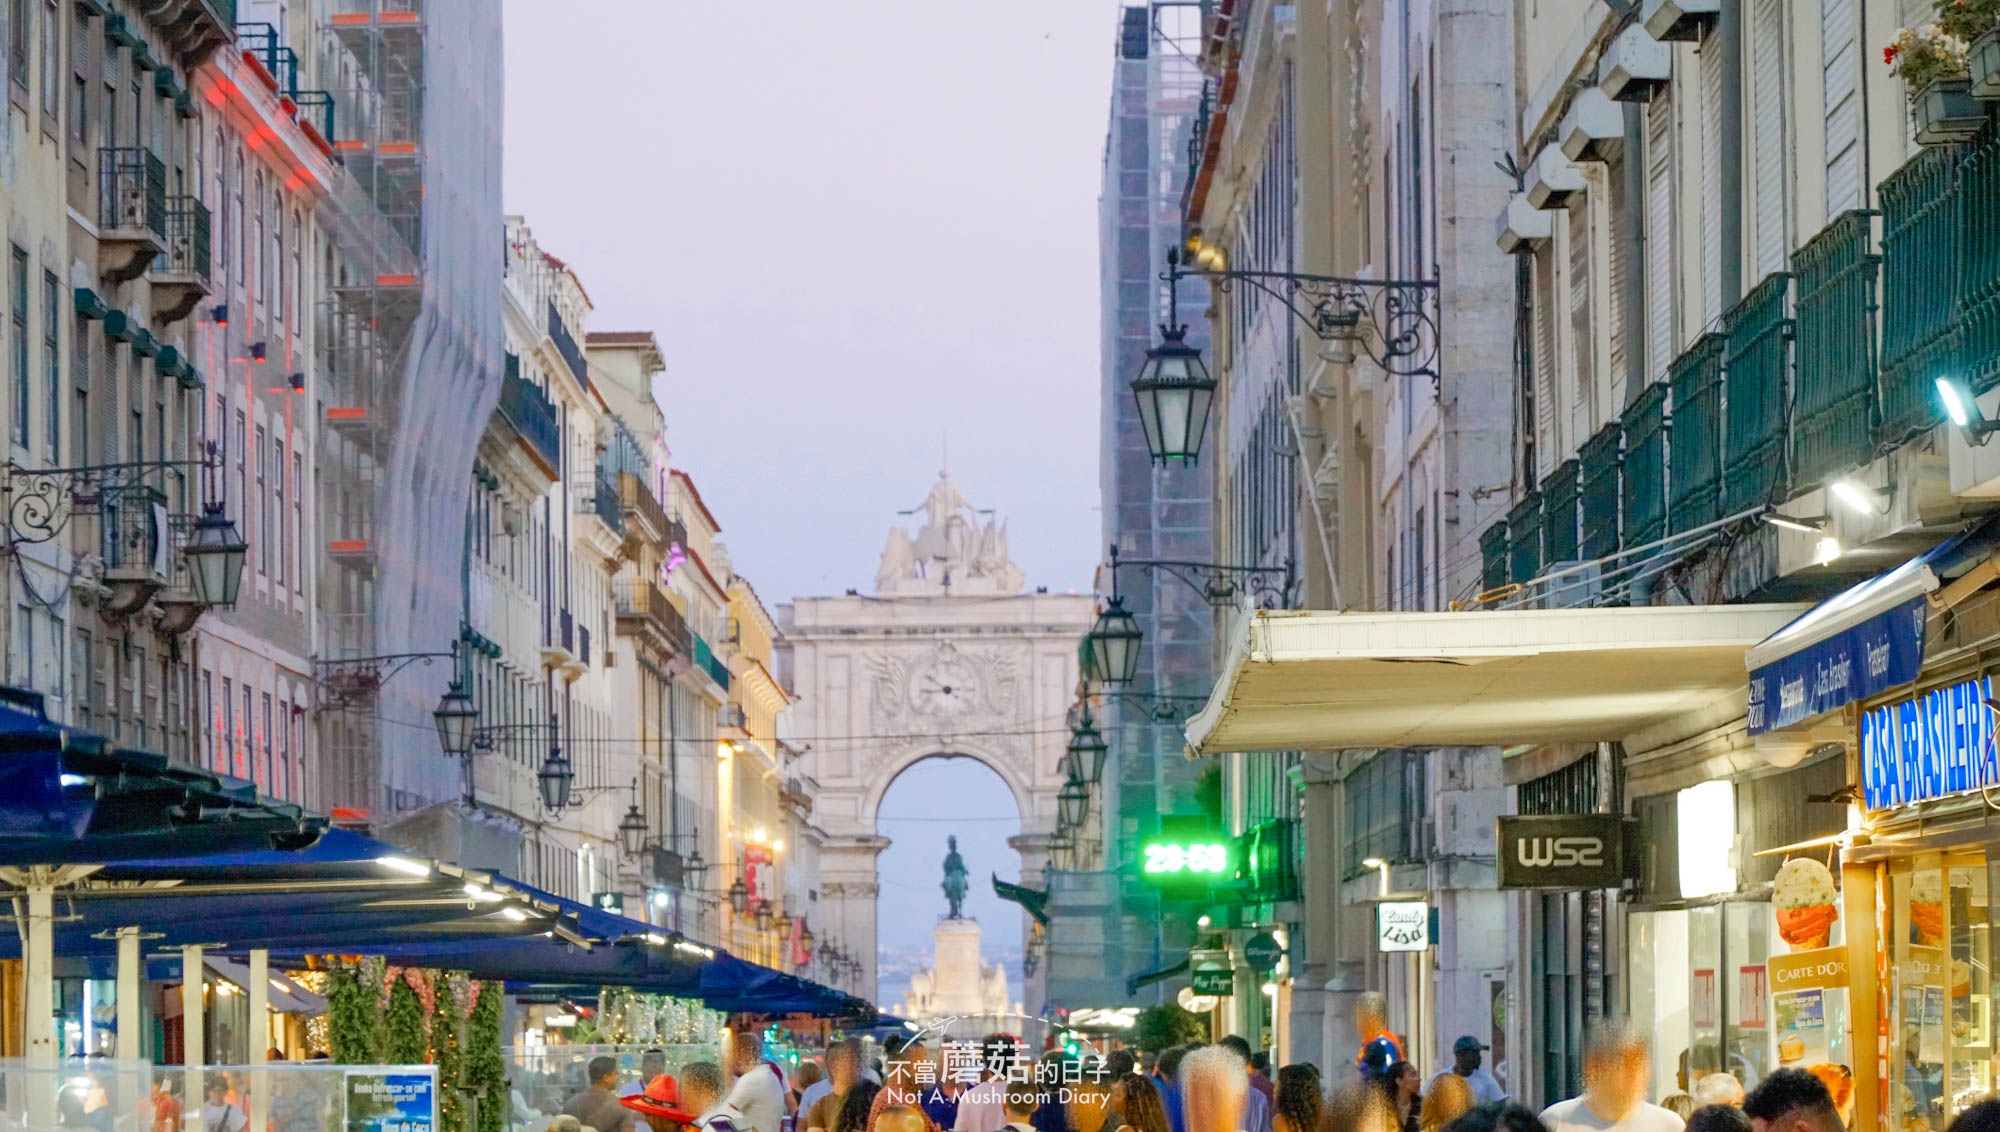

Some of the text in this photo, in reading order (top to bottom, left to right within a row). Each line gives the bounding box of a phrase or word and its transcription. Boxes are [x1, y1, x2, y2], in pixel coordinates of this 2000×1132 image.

[1862, 705, 1901, 811] CASA
[1900, 675, 1998, 803] BRASILEIRA
[1776, 966, 1814, 982] CARTE
